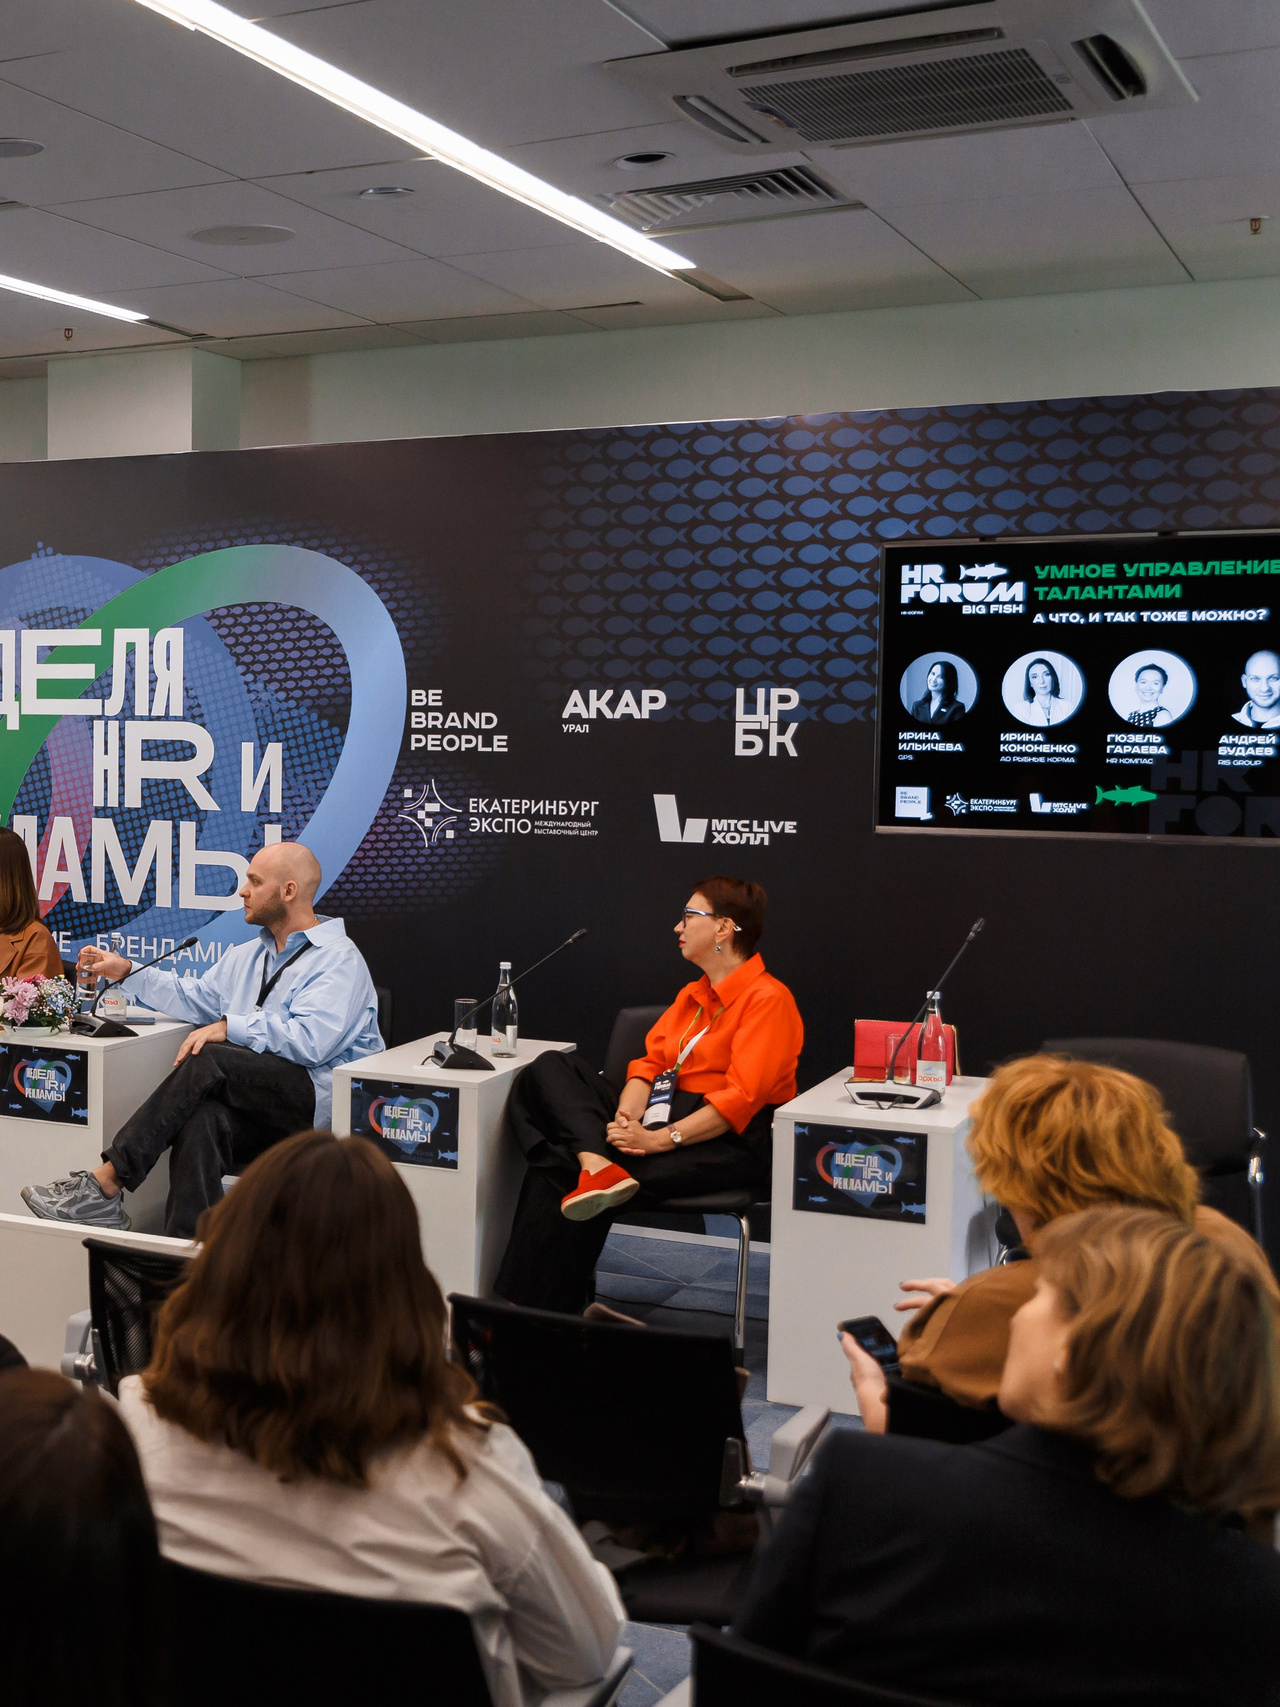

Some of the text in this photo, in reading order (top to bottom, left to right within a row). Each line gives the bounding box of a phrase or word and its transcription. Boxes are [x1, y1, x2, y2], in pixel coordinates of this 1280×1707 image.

[901, 564, 945, 584] HR
[1034, 560, 1280, 579] УМНОЕ УПРАВЛЕНИЕ
[901, 582, 1024, 604] FORUM
[1034, 584, 1183, 600] ТАЛАНТАМИ
[962, 604, 1023, 614] BIG FISH
[1032, 609, 1268, 624] А ЧТО, И ТАК ТОЖЕ МОЖНО?
[410, 690, 442, 706] BE
[562, 689, 667, 720] АКАР
[410, 712, 498, 730] BRAND
[562, 724, 589, 734] УРАЛ
[410, 734, 508, 752] PEOPLE
[898, 732, 940, 741] ИРИНА
[1000, 733, 1044, 742] ИРИНА
[1106, 734, 1162, 743] ГЮЗЕЛЬ
[1218, 733, 1276, 744] АНДРЕЙ
[898, 742, 963, 752] ИЛЬИЧЕВА
[1000, 744, 1076, 753] КОНОНЕНКО
[1106, 745, 1168, 754] ГАРАЕВА
[1218, 746, 1274, 756] БУДАЕВ
[93, 720, 221, 811] HR
[468, 798, 600, 817] ЕКАТЕРИНБУРГ
[468, 818, 532, 835] ЭКСПО
[534, 820, 592, 828] МЕЖДУНАРОДНЫЙ
[752, 820, 797, 834] LIVE
[534, 828, 579, 836] ВЫСТАВОЧНЫЙ
[711, 831, 770, 846] ХОЛЛ
